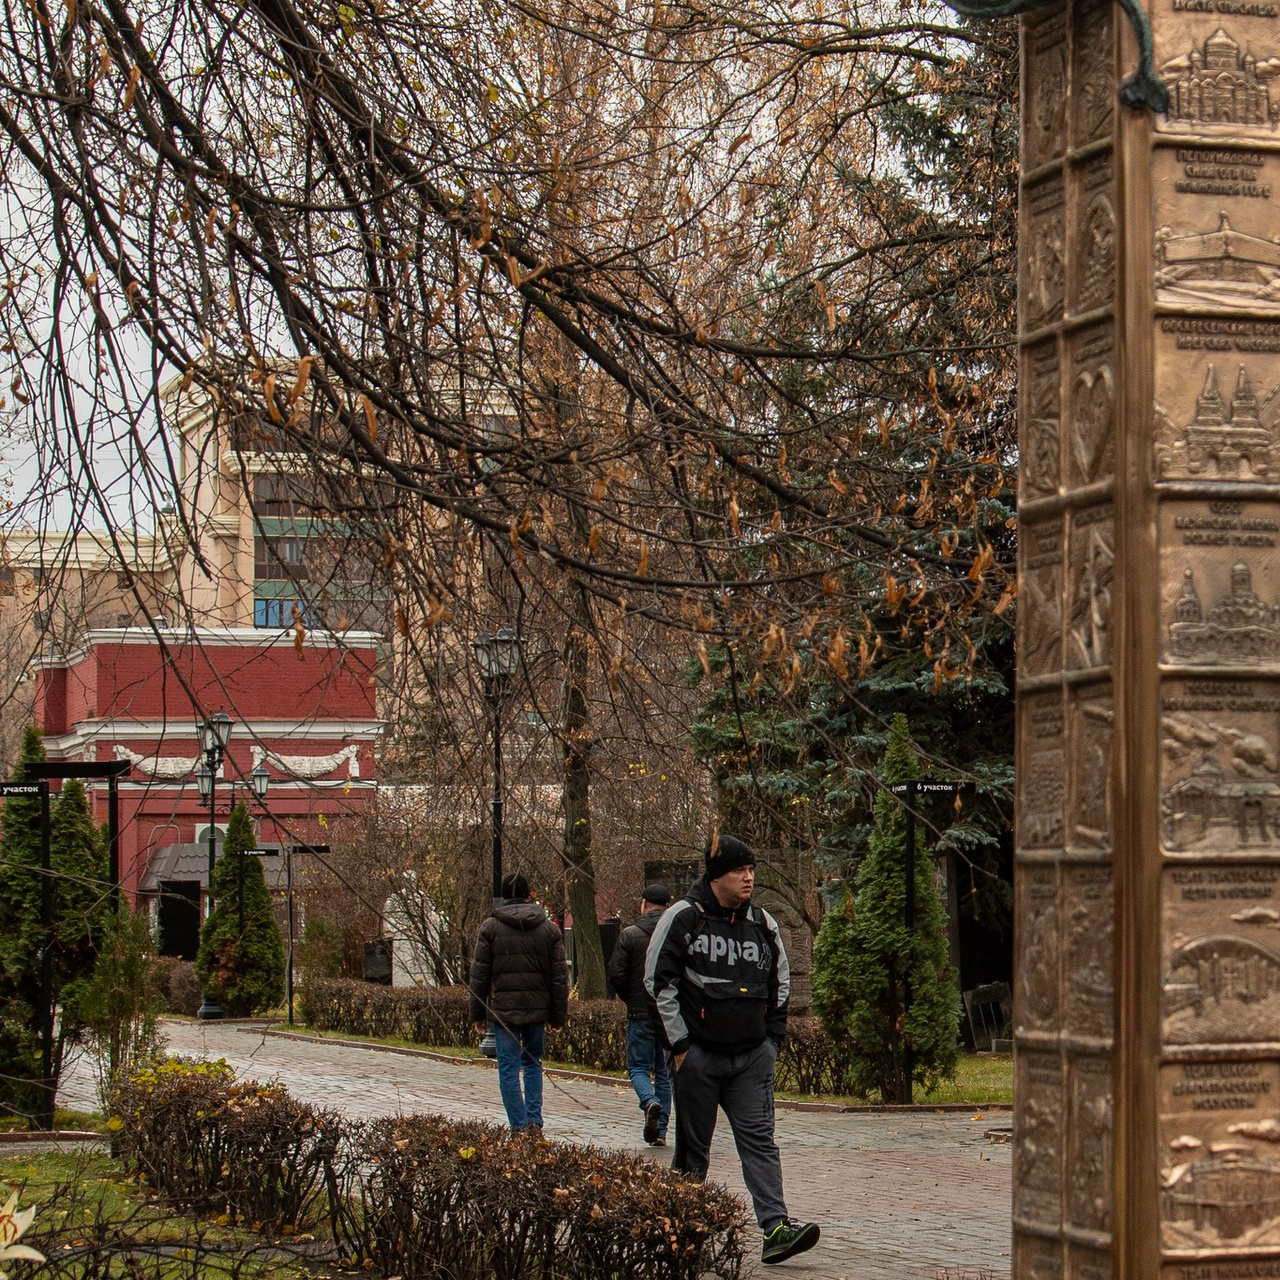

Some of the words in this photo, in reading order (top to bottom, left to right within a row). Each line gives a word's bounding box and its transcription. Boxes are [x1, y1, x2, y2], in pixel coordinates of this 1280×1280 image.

[3, 786, 39, 795] участок
[916, 783, 922, 791] 6
[923, 784, 953, 792] участок
